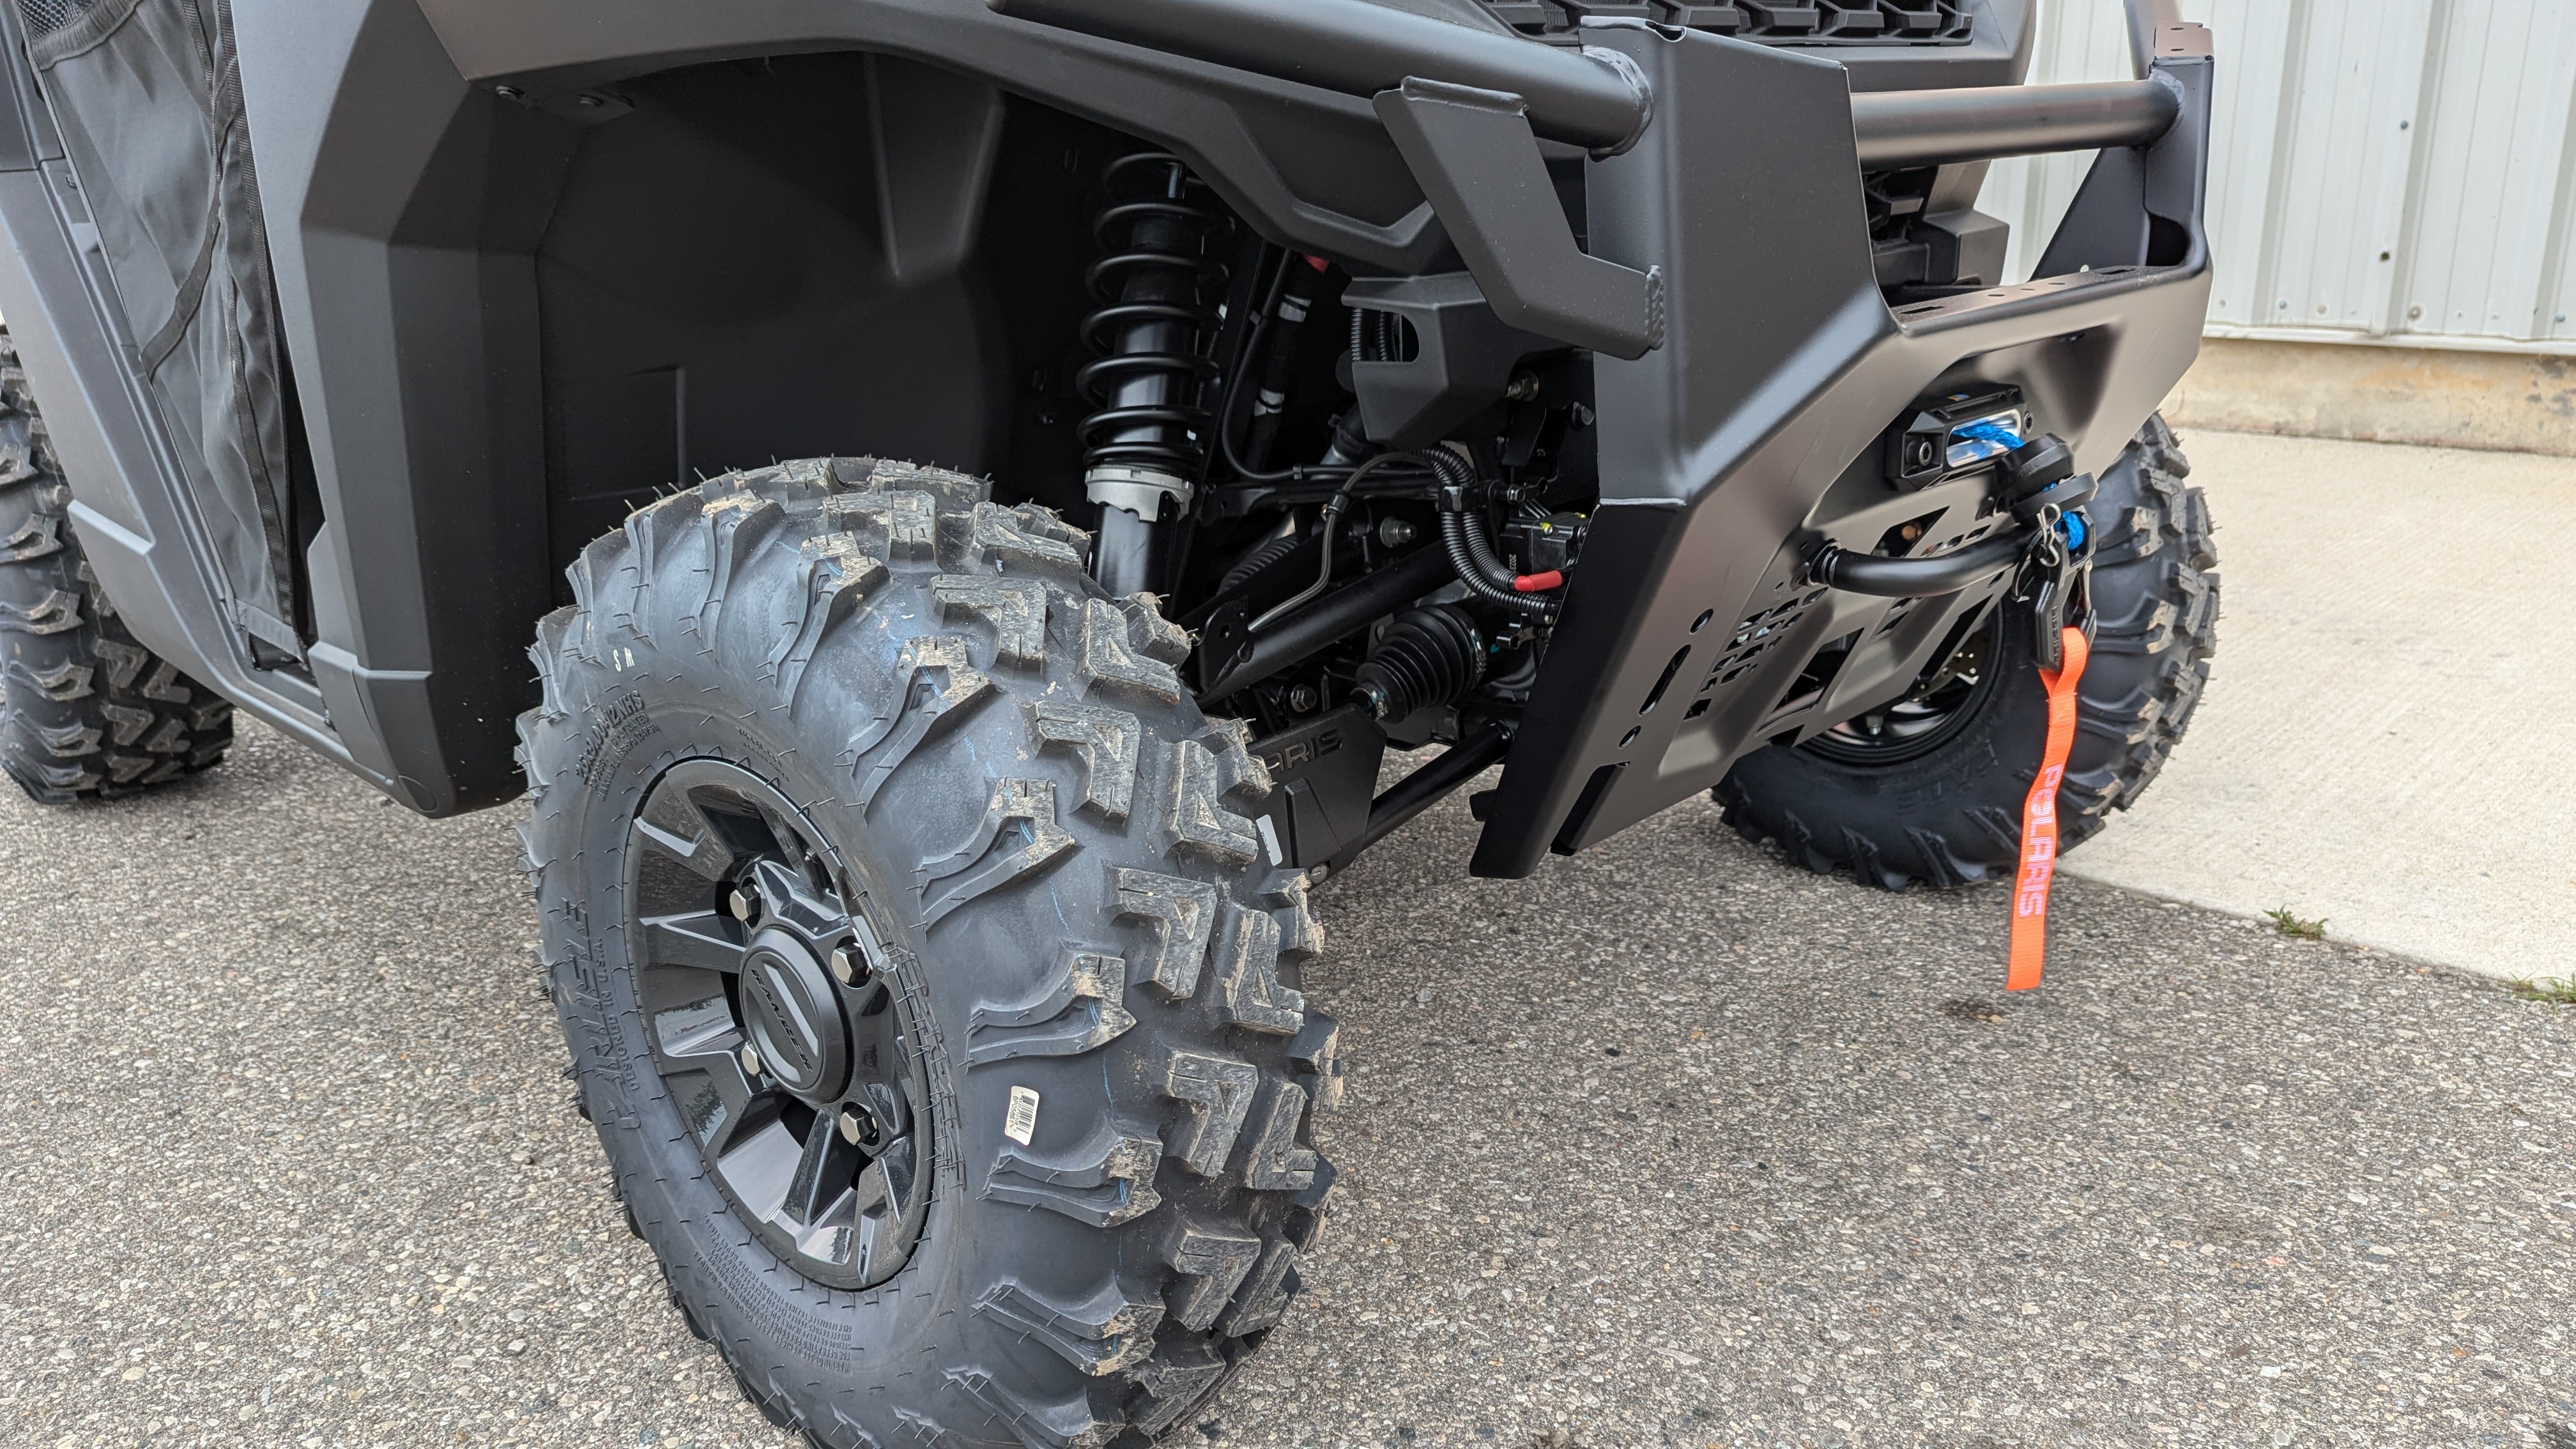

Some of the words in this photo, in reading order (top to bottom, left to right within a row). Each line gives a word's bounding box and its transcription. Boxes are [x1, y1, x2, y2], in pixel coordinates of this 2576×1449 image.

[2019, 764, 2062, 917] POLARIS
[601, 989, 614, 1008] IN
[751, 969, 814, 1073] RANGER
[606, 1013, 640, 1092] DESIGNED
